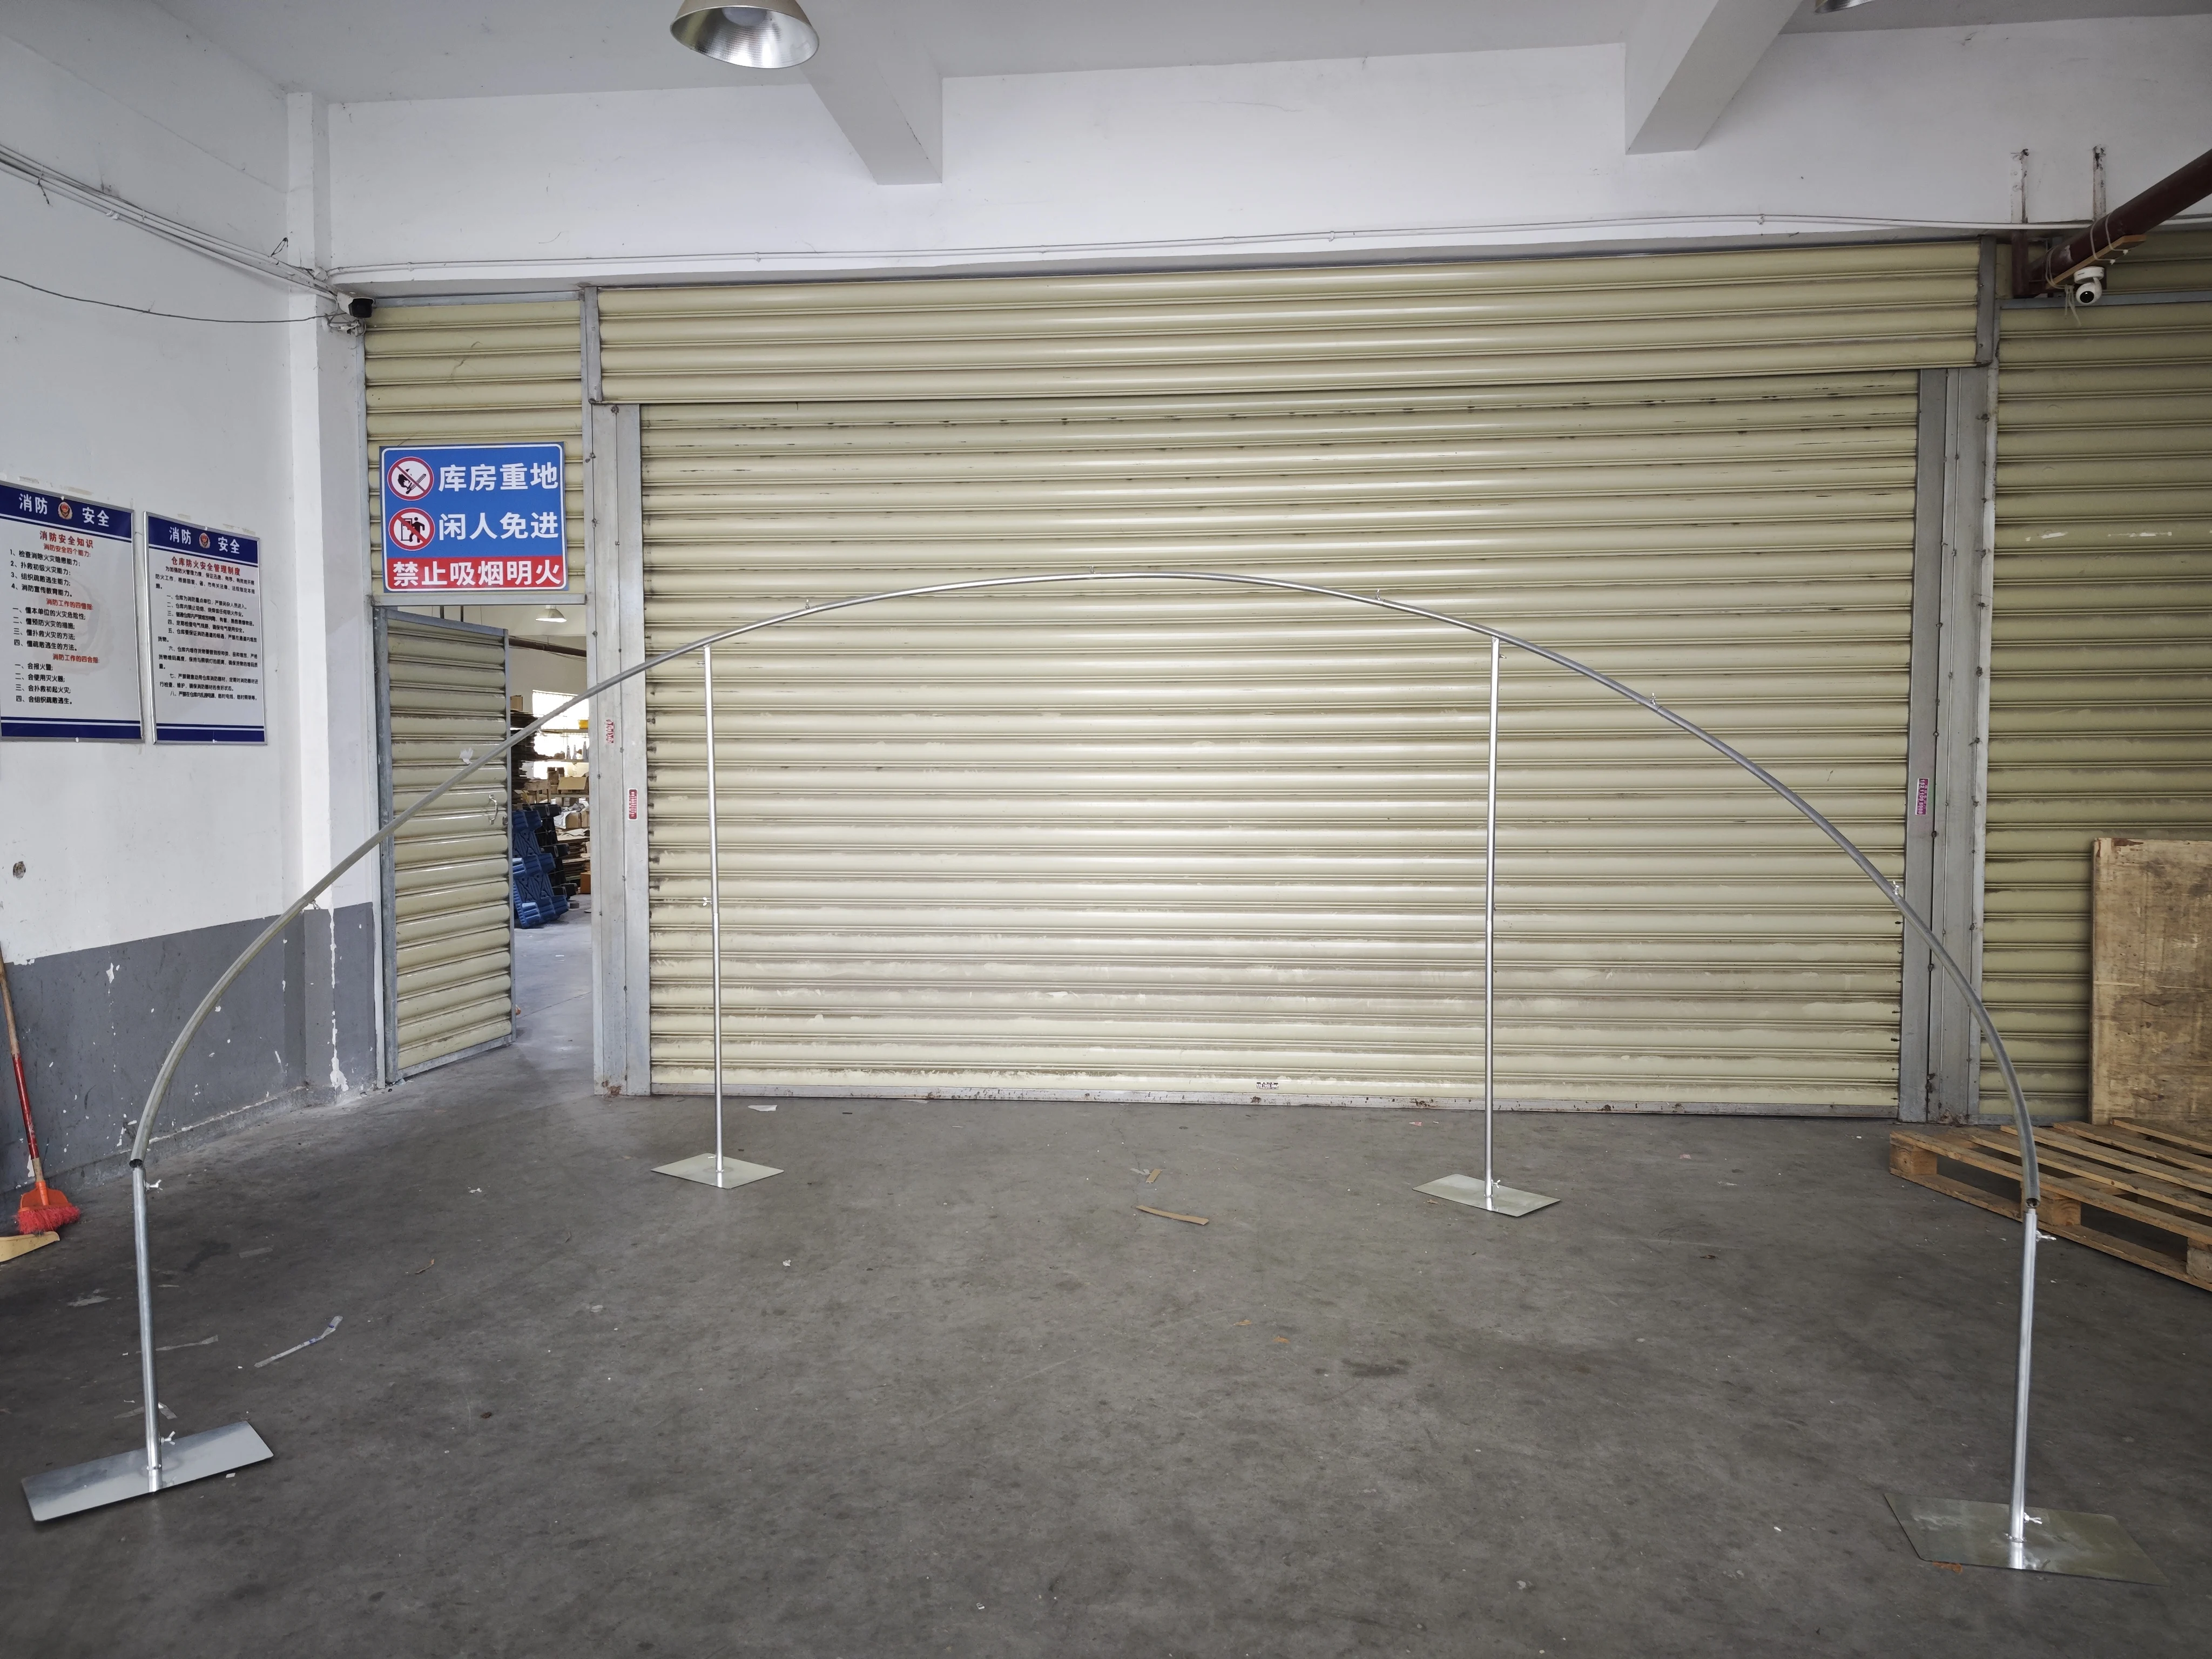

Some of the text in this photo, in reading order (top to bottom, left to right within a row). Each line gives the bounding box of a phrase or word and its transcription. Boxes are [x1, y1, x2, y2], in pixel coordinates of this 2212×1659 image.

[439, 462, 558, 492] 库房重地
[19, 493, 110, 527] 消防 安全
[39, 530, 93, 549] 消防安全知识
[439, 512, 558, 540] 闲人免进
[169, 527, 240, 554] 消防 安全
[171, 556, 240, 576] 仓库防火安全管理制度
[393, 559, 561, 587] 禁止吸烟明火
